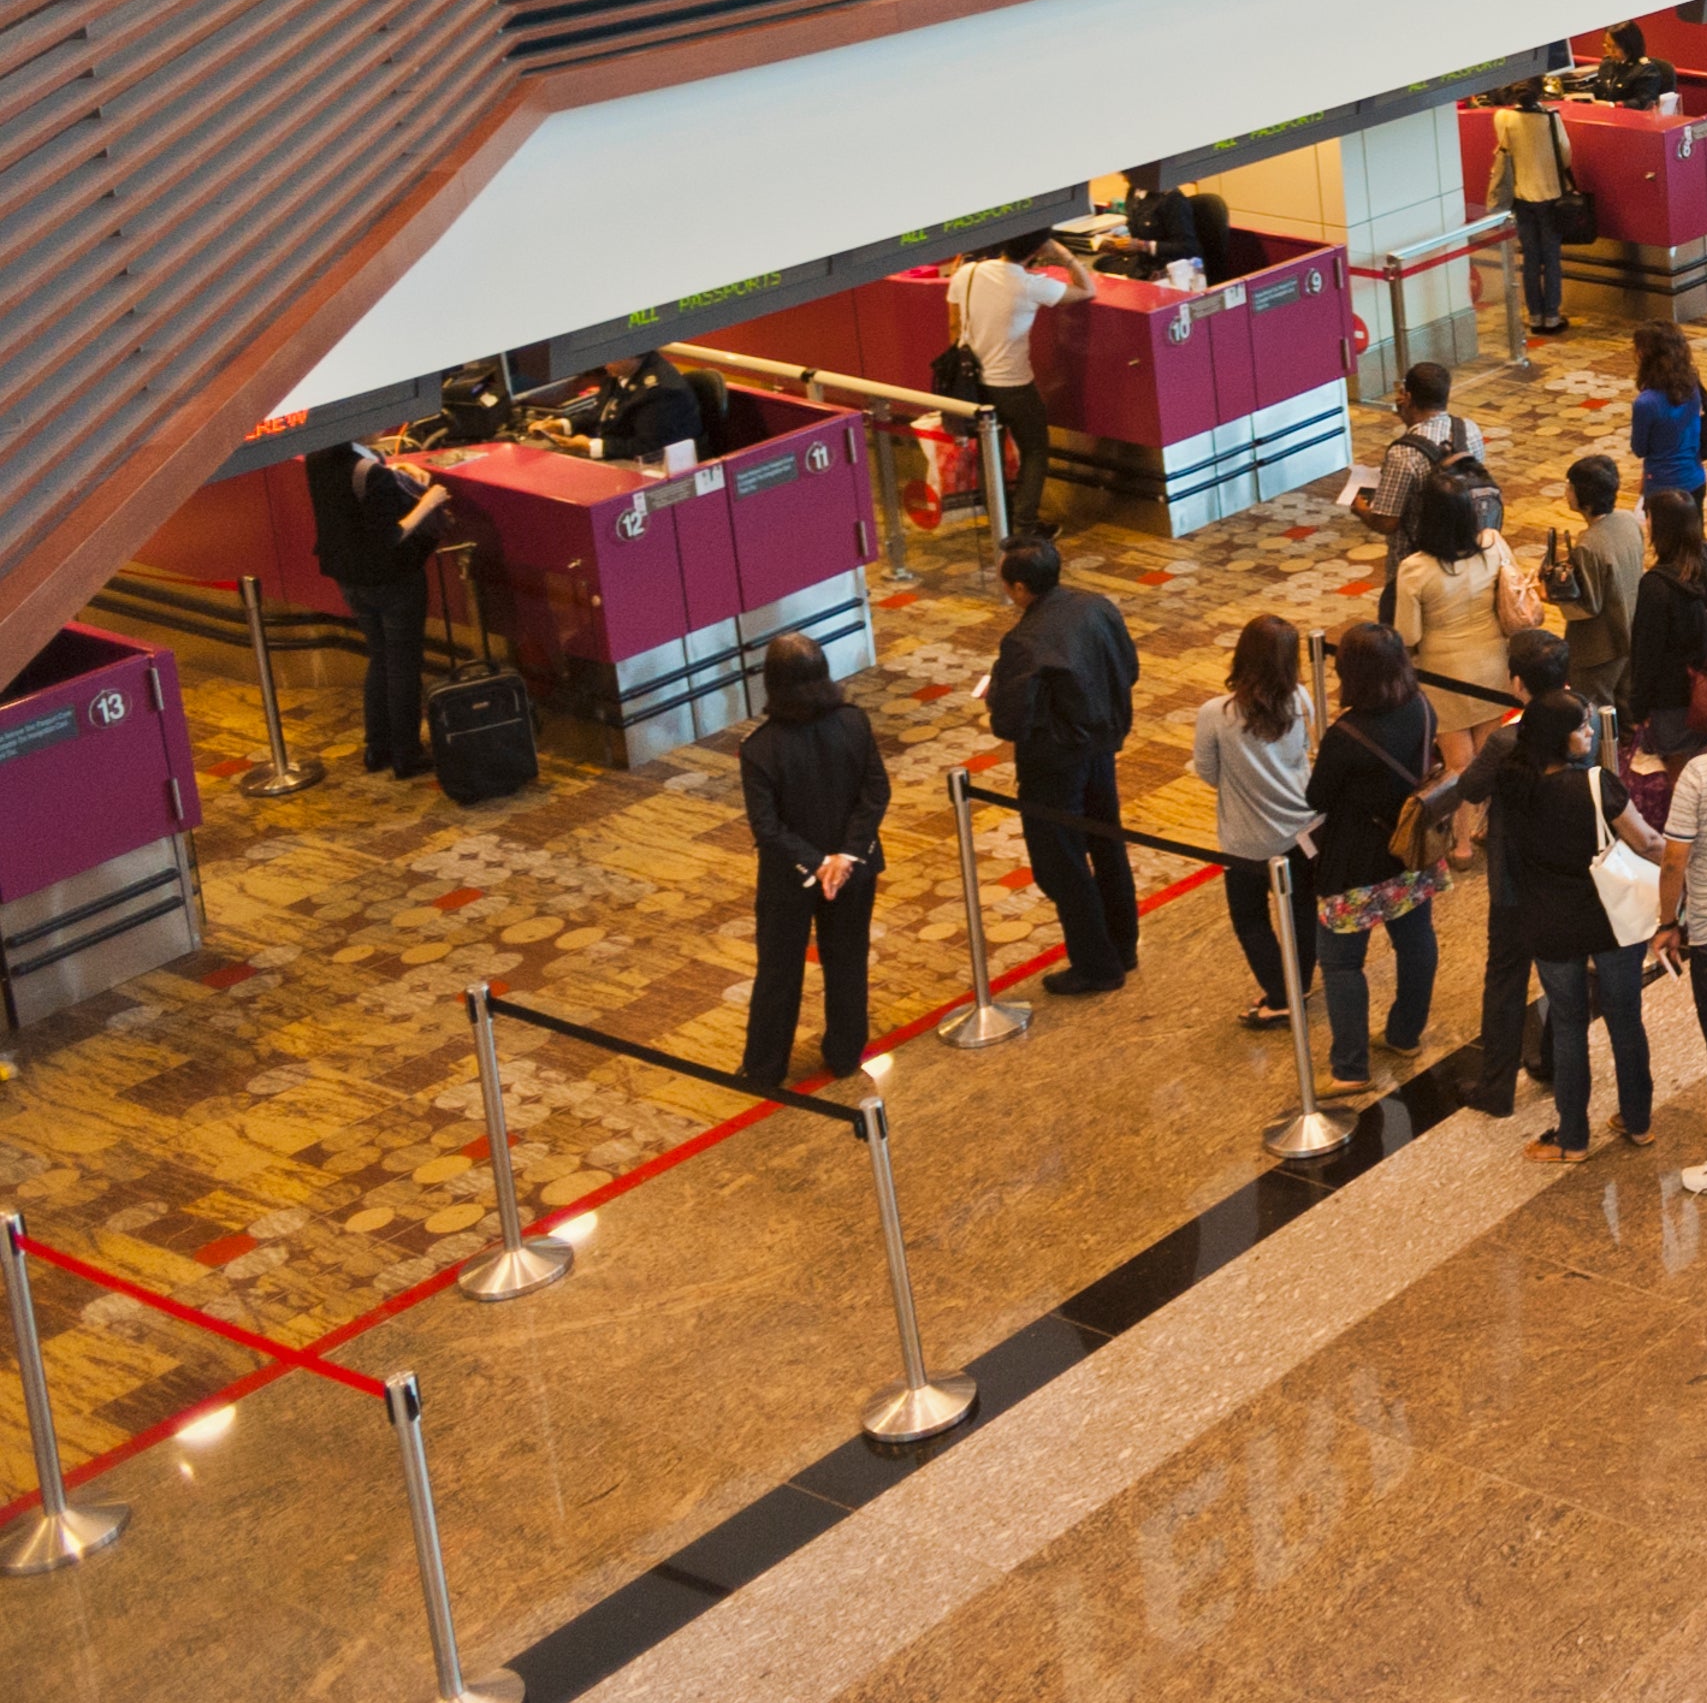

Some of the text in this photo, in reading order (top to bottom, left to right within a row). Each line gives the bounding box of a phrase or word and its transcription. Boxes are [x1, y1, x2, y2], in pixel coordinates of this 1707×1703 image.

[628, 271, 782, 329] ALL PASSPORTS
[1171, 320, 1190, 342] 10
[622, 445, 830, 538] 12 11
[96, 693, 126, 724] 13
